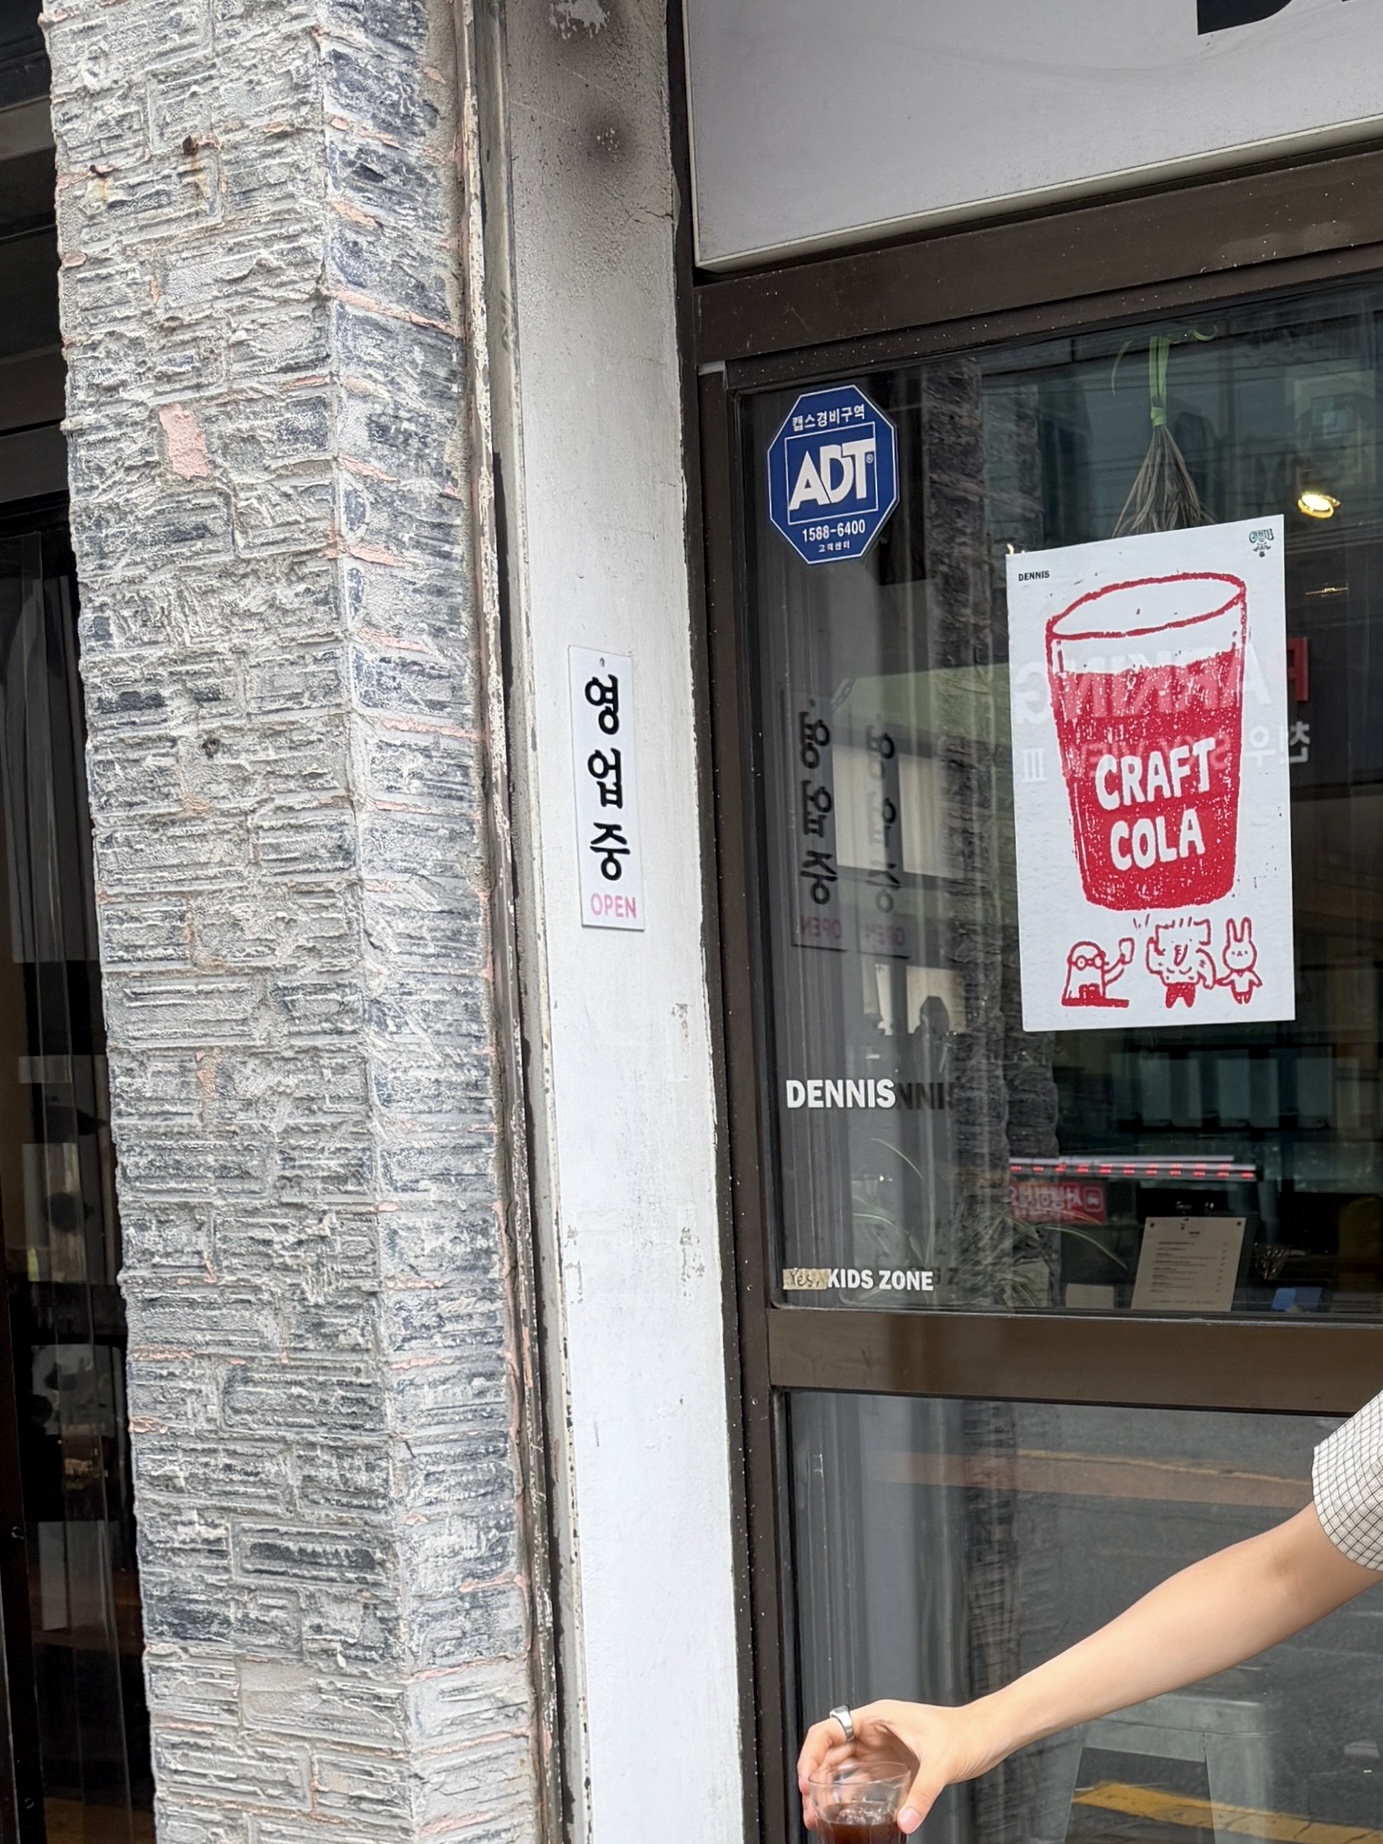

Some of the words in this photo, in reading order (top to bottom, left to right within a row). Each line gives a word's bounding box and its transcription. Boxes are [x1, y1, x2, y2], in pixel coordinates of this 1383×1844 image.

[792, 404, 865, 432] 캡스경비구역
[789, 437, 876, 511] ADT
[802, 519, 866, 543] 1588-6400
[1018, 570, 1050, 582] DENNIS
[584, 673, 631, 881] 영업중
[1094, 736, 1216, 811] CRAFT
[1109, 806, 1206, 871] COLA
[590, 892, 637, 919] OPEN
[785, 1078, 897, 1109] DENNIS
[827, 1268, 874, 1289] KIDS
[878, 1269, 934, 1291] ZONE
